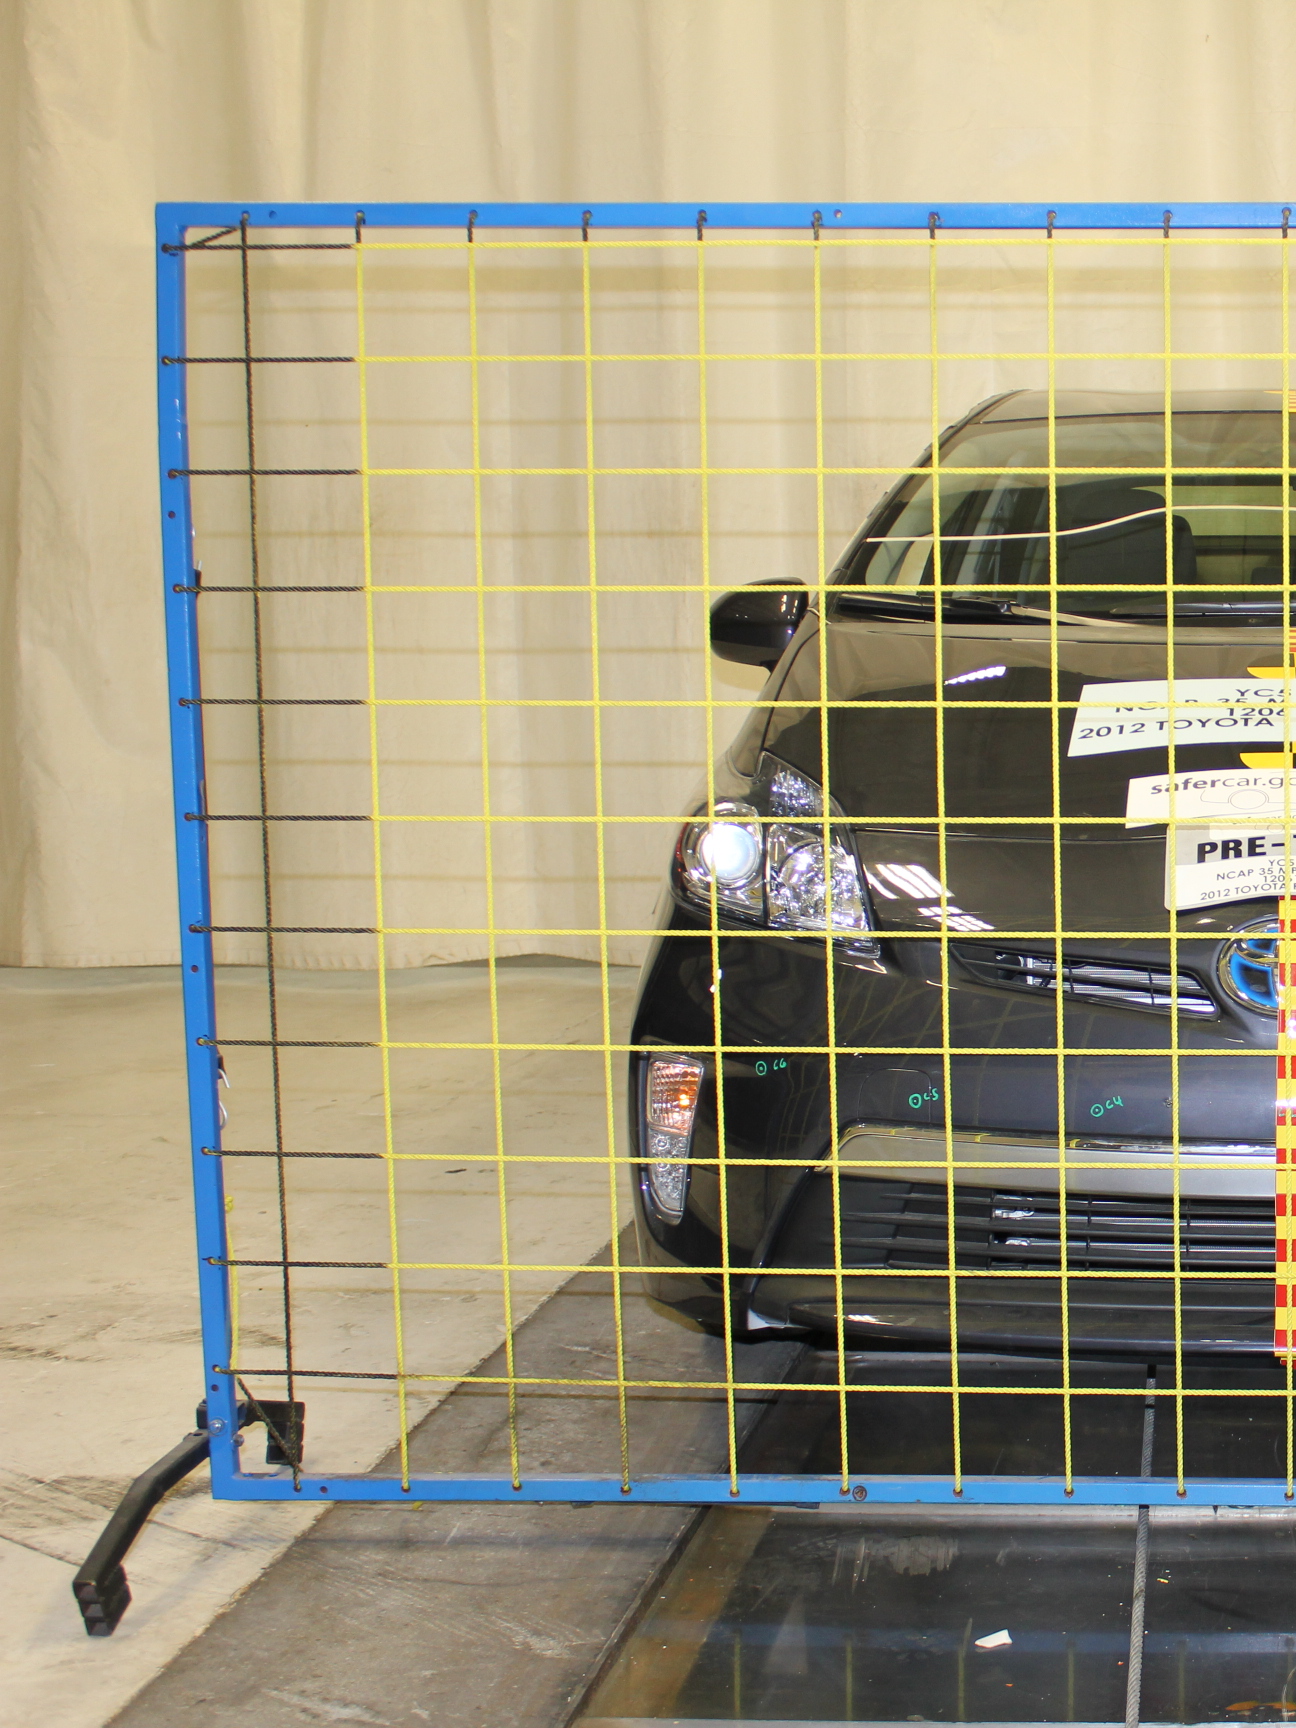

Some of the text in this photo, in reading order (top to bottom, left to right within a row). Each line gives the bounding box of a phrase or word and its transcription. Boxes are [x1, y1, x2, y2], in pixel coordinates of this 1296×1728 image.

[1077, 722, 1147, 740] 2012
[1155, 717, 1276, 731] TOYOTA
[1216, 868, 1255, 882] NCAP
[1258, 867, 1274, 876] 35
[1200, 888, 1231, 901] 2012
[1234, 882, 1287, 894] TOYOTA
